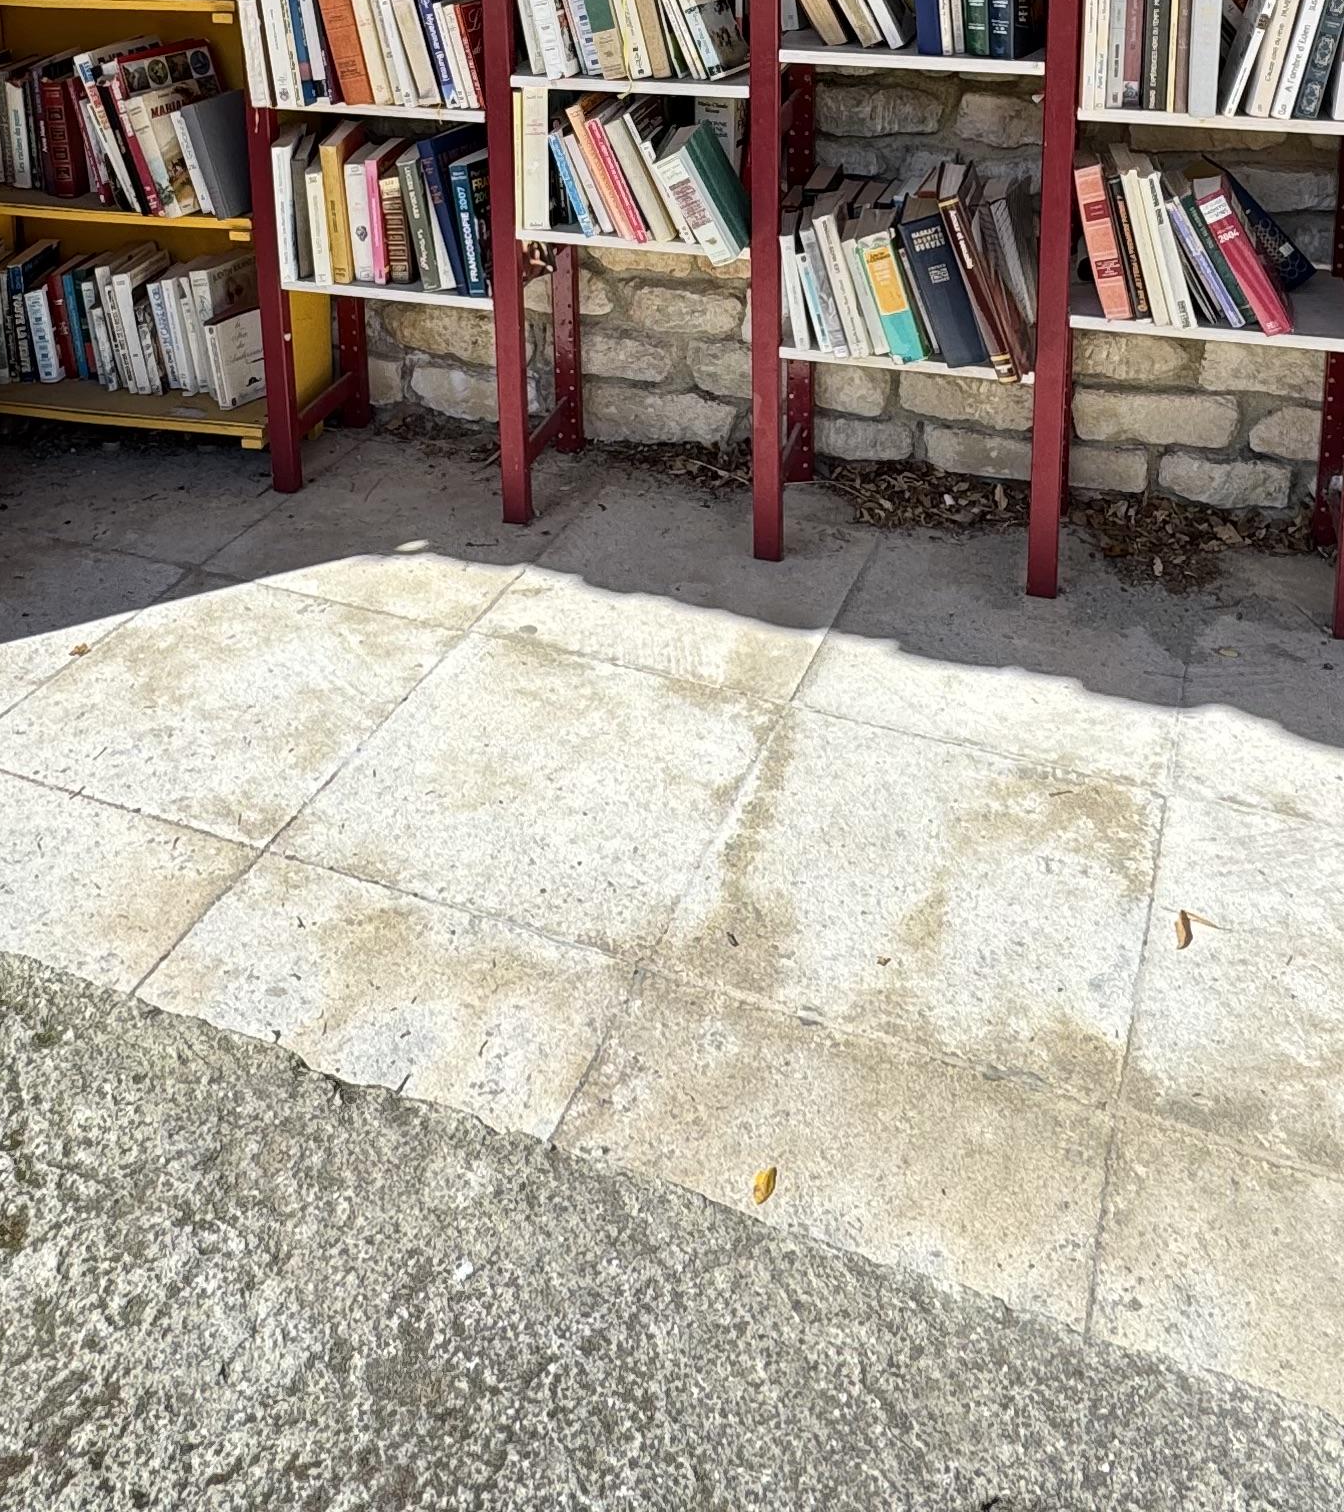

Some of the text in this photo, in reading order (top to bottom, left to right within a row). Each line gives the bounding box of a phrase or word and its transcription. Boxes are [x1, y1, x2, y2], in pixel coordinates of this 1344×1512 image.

[456, 185, 479, 282] FRANCOSCOPIE 2007
[1218, 228, 1240, 244] 2004
